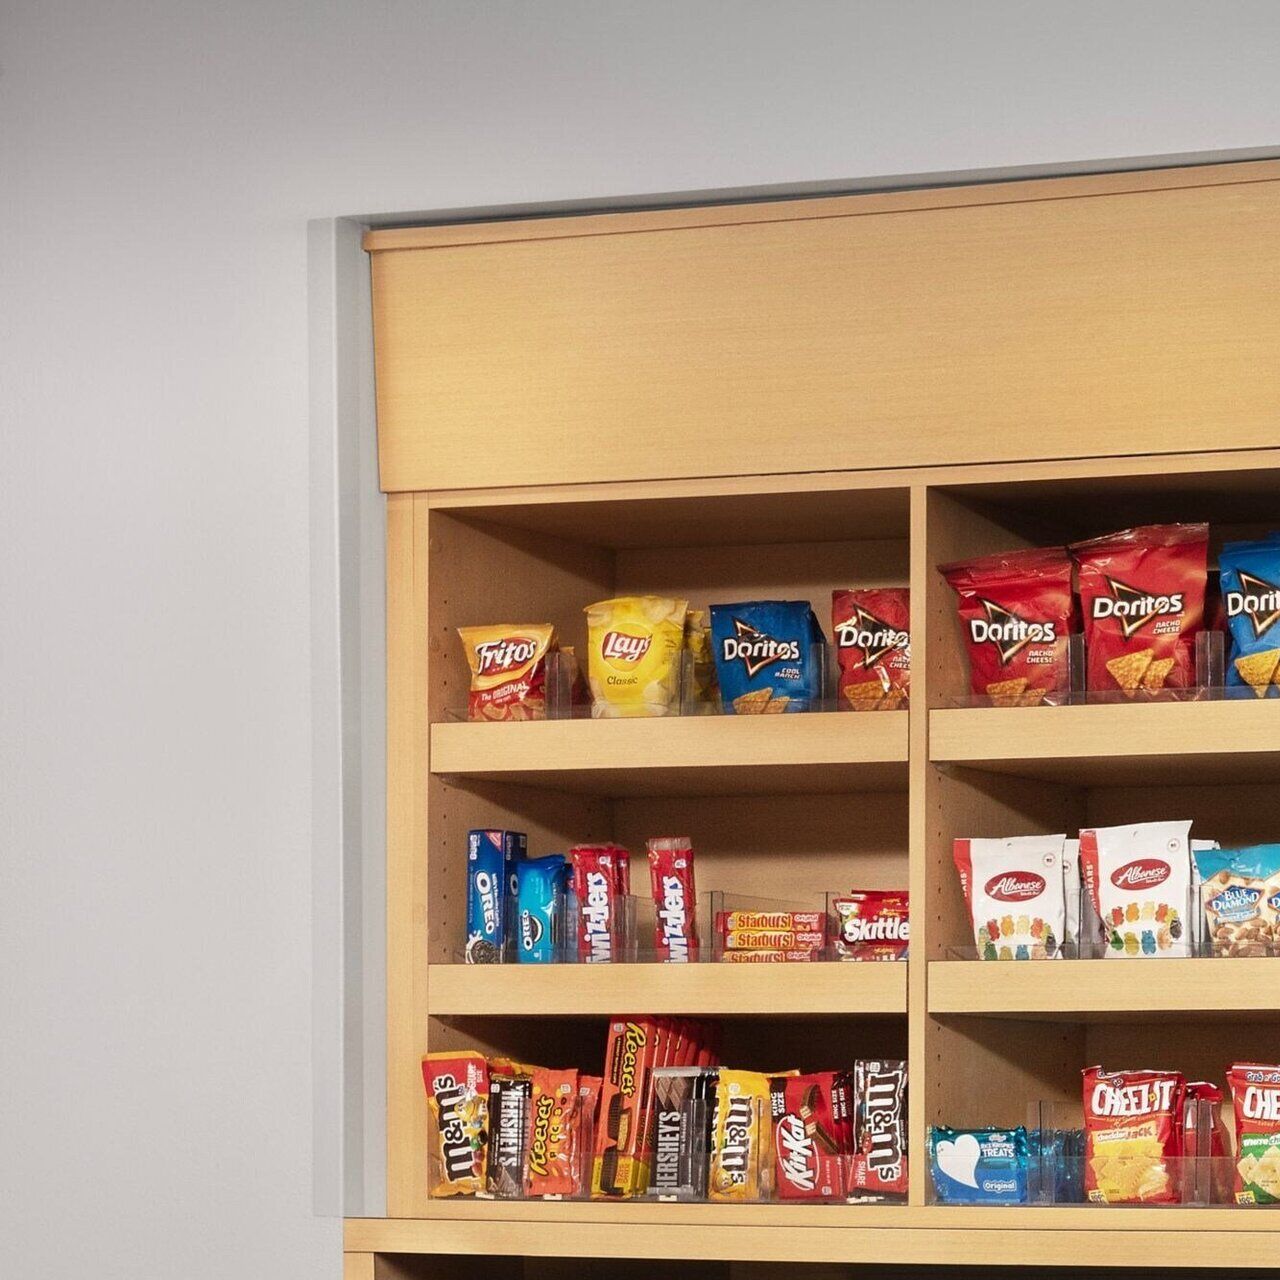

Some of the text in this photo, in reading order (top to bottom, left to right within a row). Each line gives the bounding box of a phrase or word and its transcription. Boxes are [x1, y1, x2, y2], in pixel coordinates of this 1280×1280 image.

[1093, 594, 1183, 619] Doritos
[970, 619, 1056, 643] Doritos
[1152, 626, 1180, 634] CHEESE
[1155, 619, 1181, 628] NACHO
[475, 640, 537, 674] Fritos
[723, 638, 800, 660] Doritos
[606, 675, 638, 685] Classic
[1116, 865, 1168, 886] Albanese
[989, 877, 1044, 897] Albanese
[1223, 888, 1248, 900] BLUE
[475, 870, 495, 935] OREO
[1211, 892, 1259, 911] DIAMOND
[522, 909, 534, 951] OREO
[737, 913, 792, 928] Starburst
[737, 932, 795, 947] Starburst
[620, 1020, 647, 1097] Reese's
[529, 1094, 555, 1176] Reese's
[982, 1148, 1014, 1158] TREATS
[984, 1181, 1016, 1191] Original
